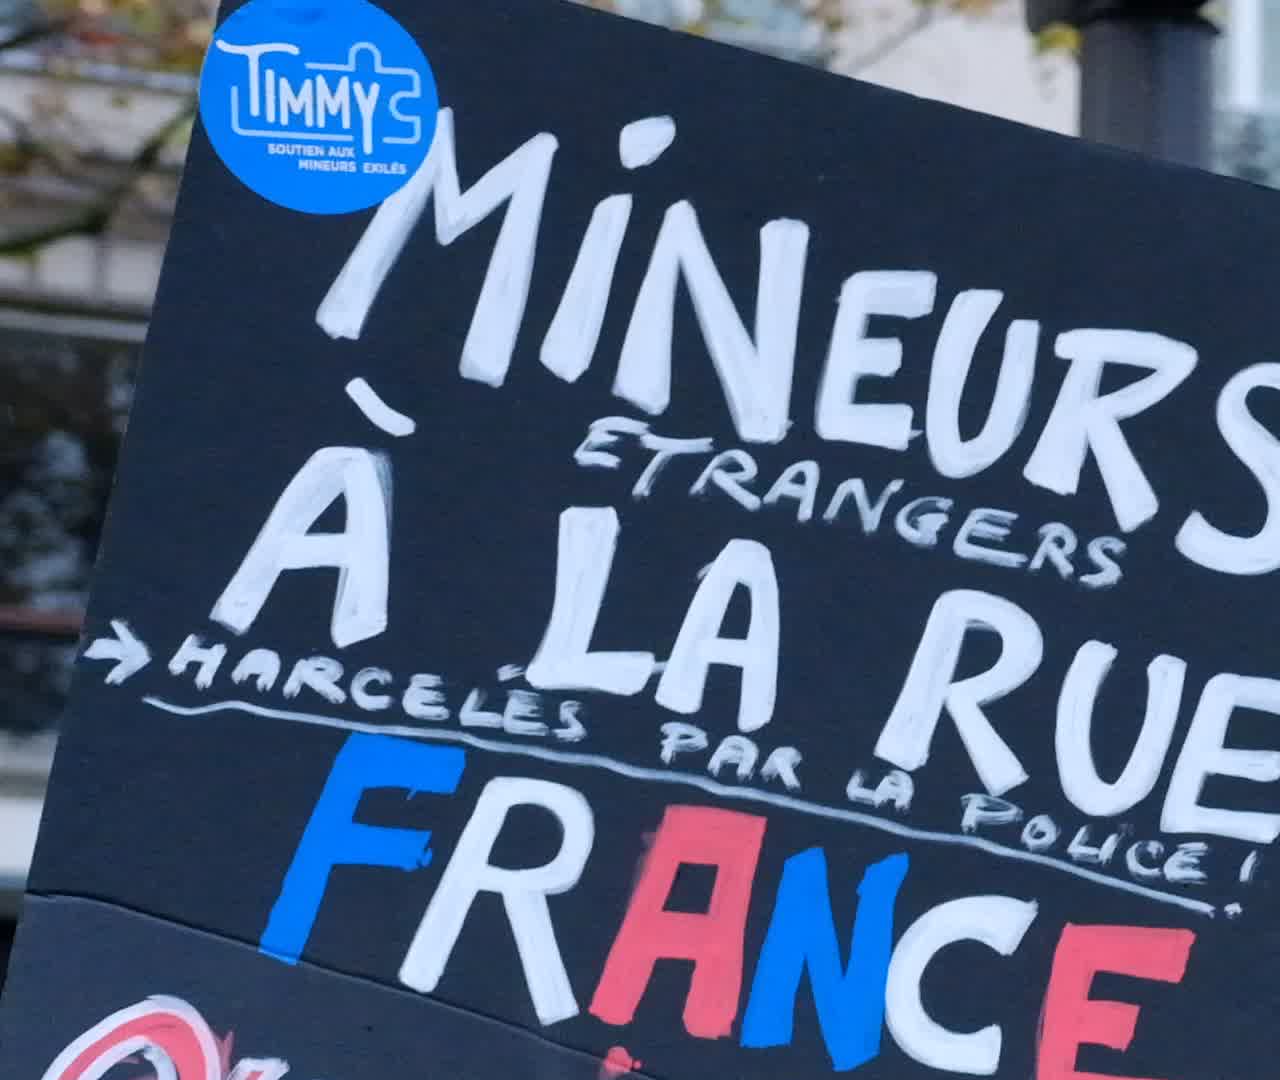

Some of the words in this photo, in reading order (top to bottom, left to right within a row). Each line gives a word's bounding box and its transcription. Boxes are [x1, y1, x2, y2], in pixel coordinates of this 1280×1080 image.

[268, 143, 324, 157] SOUTIEN
[328, 145, 355, 158] AUX
[298, 159, 357, 173] MINEURS
[210, 377, 416, 648] À
[525, 505, 781, 732] LA
[573, 416, 1128, 589] ETRANGERS
[659, 722, 803, 790] PAR
[846, 768, 915, 811] LA
[960, 793, 1209, 884] POLICE
